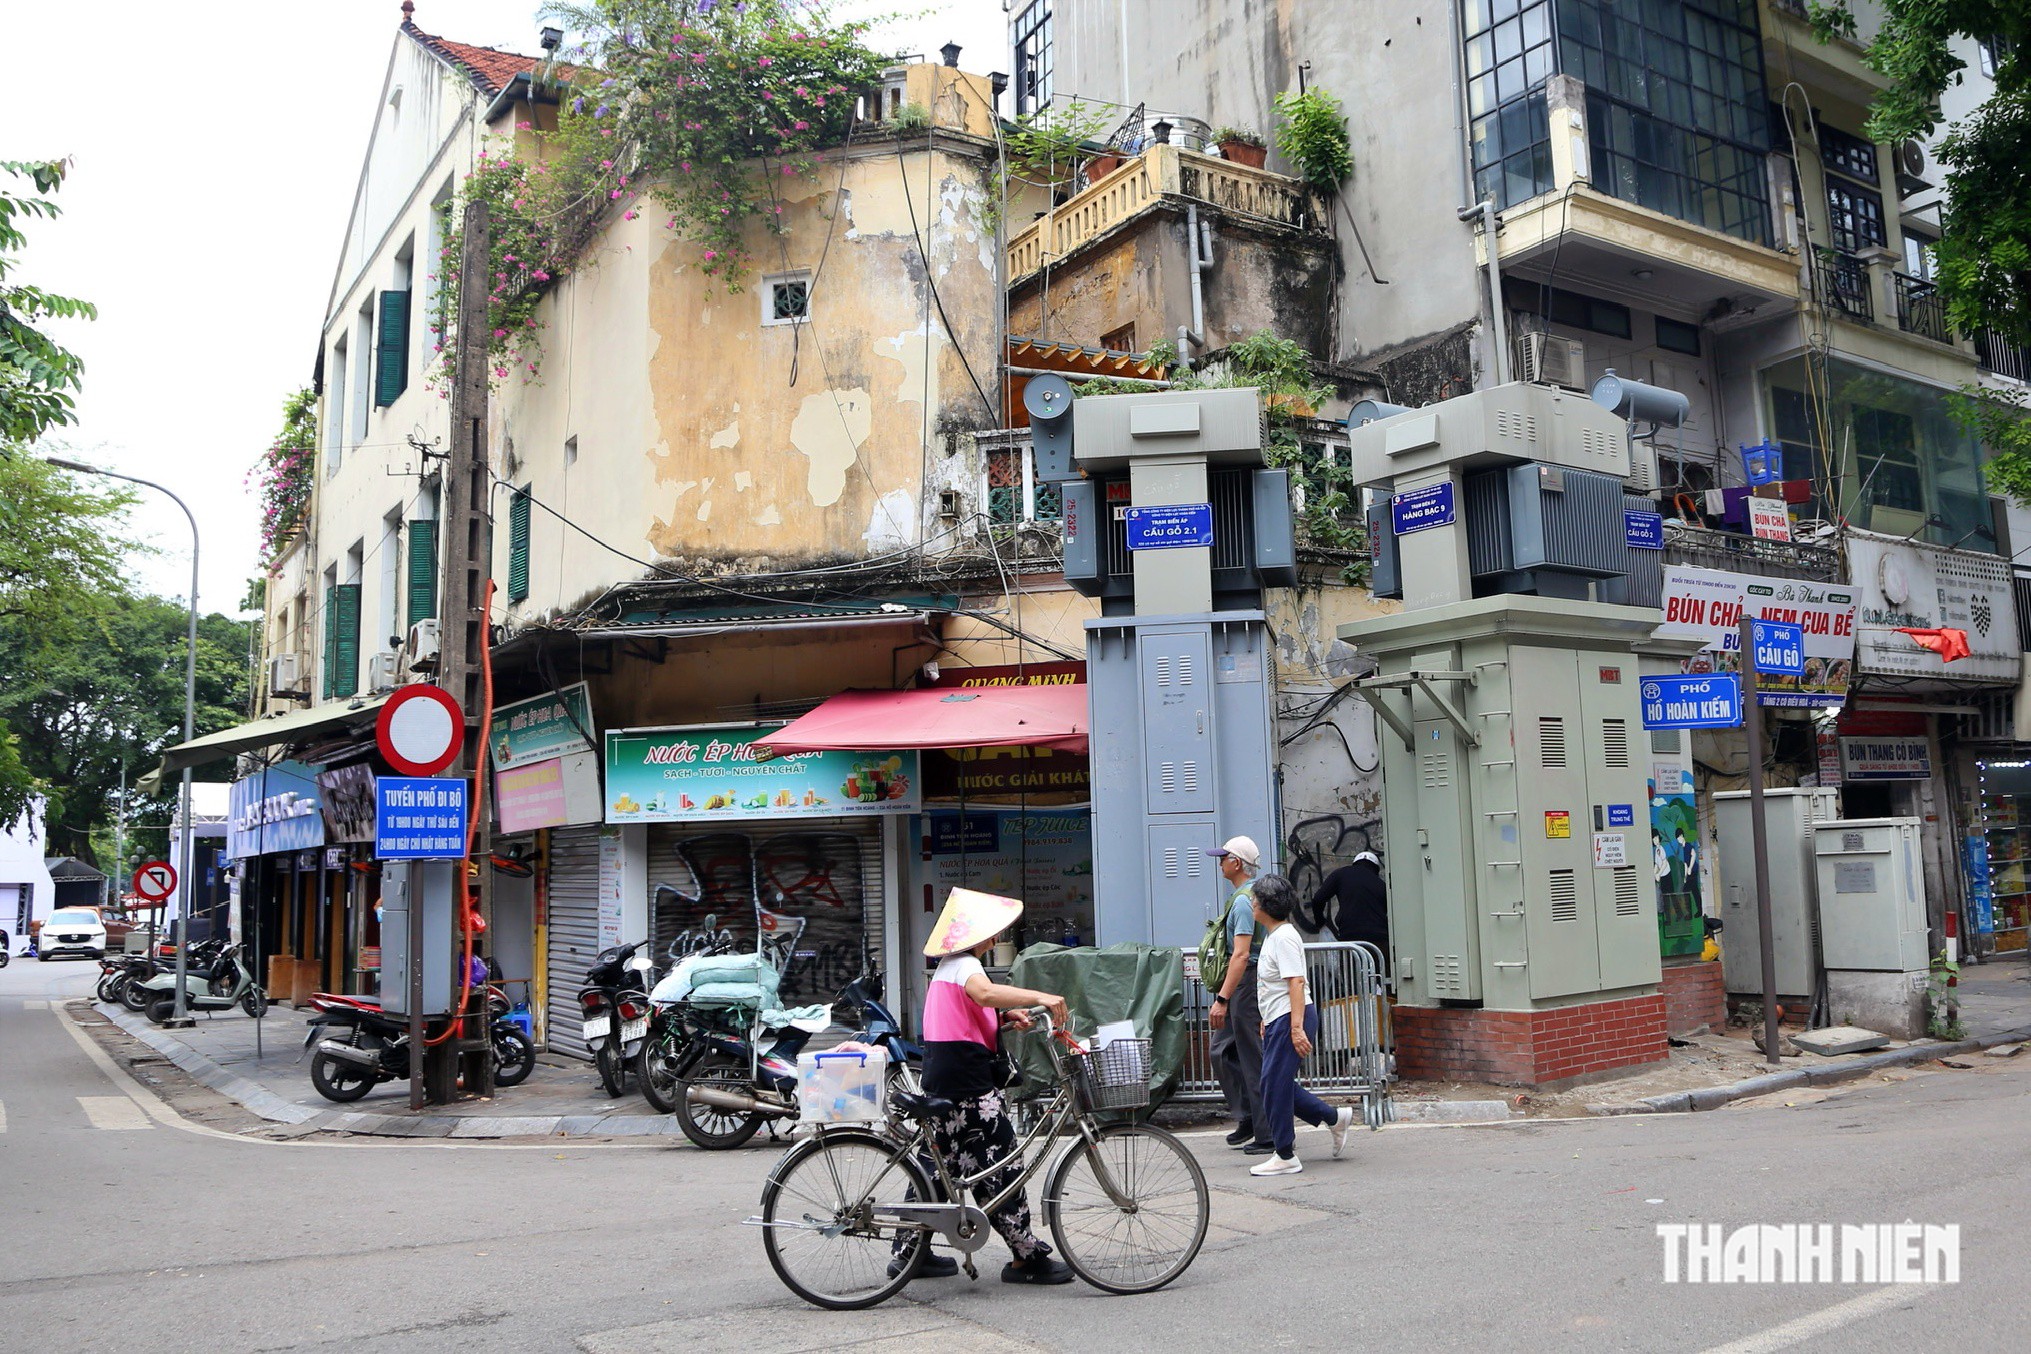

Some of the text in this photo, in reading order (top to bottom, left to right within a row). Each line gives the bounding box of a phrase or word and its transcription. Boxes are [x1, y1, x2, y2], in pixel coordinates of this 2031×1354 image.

[1402, 504, 1446, 521] HÀNG BẠC 9
[1754, 512, 1786, 527] BÚN CHẢ
[1143, 524, 1197, 537] CẦU GỖ 2.1
[1649, 531, 1653, 539] 2
[1776, 584, 1824, 604] Bà Thanh
[1666, 593, 1706, 625] BÚN
[1709, 595, 1744, 628] CHẢ
[1801, 609, 1830, 636] CUA
[1833, 605, 1857, 637] BỂ
[1773, 628, 1791, 640] PHỐ
[1757, 642, 1799, 668] CẦU GỖ
[1027, 672, 1077, 687] MINH
[1600, 669, 1620, 681] MBT
[1679, 679, 1711, 694] PHỐ
[1647, 695, 1731, 722] HỒ HOÀN KIẾM
[1776, 696, 1781, 706] 2
[643, 739, 700, 765] NƯỚC
[702, 738, 733, 764] ÉP
[1848, 741, 1867, 761] BÚN
[1867, 743, 1894, 761] THANG
[663, 762, 808, 781] SẠCH TƯƠI NGUYÊN CHẤT
[385, 784, 462, 812] TUYẾN PHỐ ĐI BỘ
[1612, 808, 1628, 816] KHOANG
[387, 814, 395, 829] TỪ
[412, 814, 425, 829] NGÀY
[426, 814, 437, 829] THỨ
[437, 814, 448, 829] SÁU
[448, 813, 460, 829] ĐẾN
[1036, 816, 1088, 835] JUICE
[380, 833, 461, 852] 24H00 NGÀY CHỦ NHẬT HÀNG TUẦN
